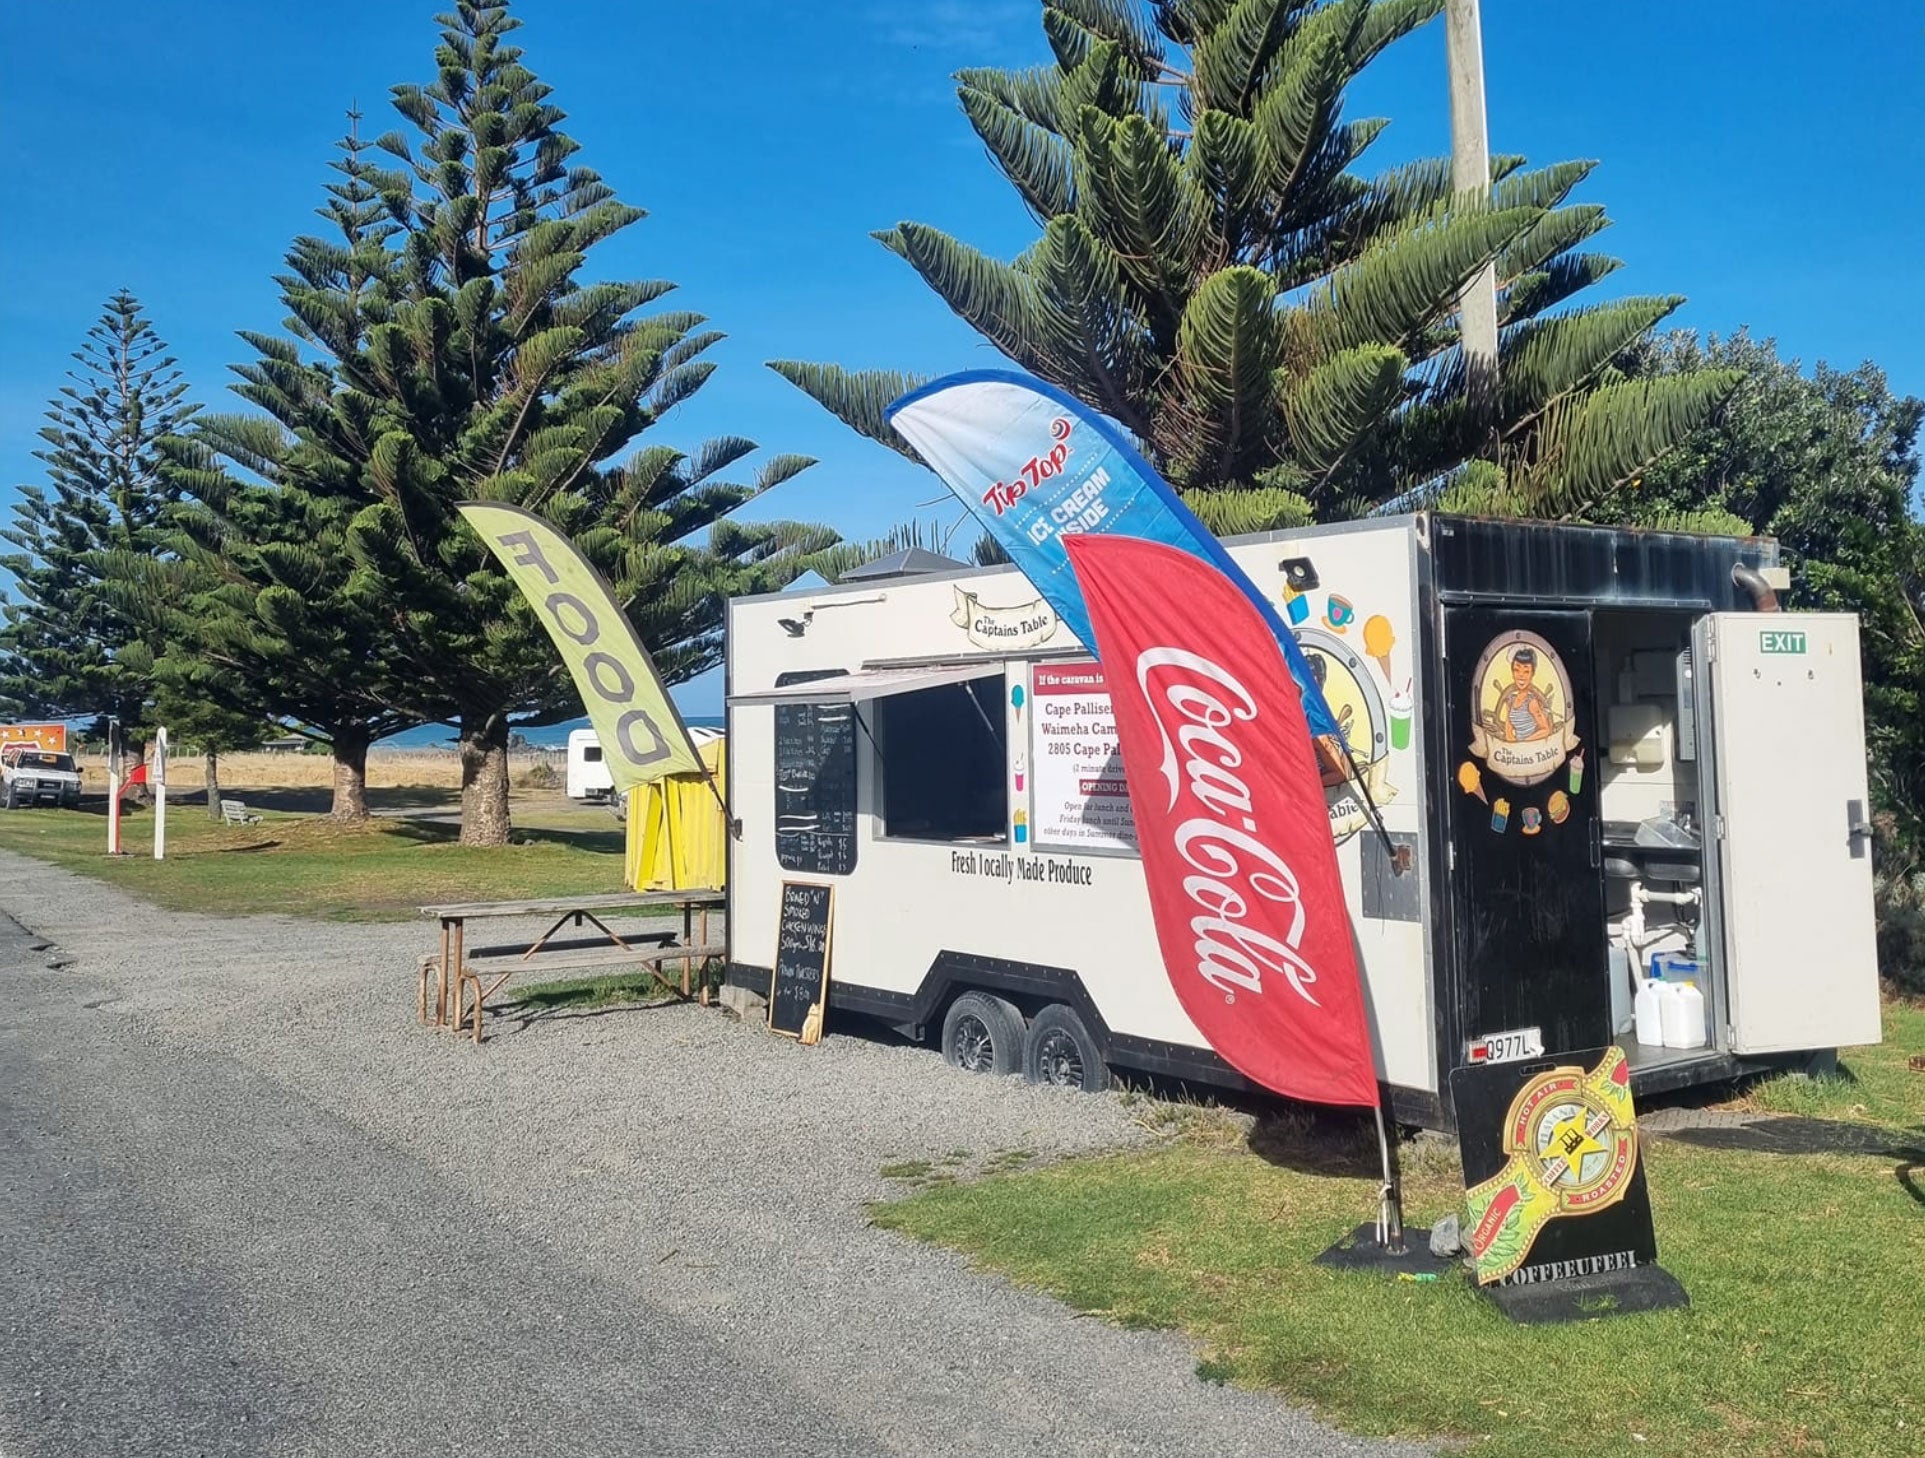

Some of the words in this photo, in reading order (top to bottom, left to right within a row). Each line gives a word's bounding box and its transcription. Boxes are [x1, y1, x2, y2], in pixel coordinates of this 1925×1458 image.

[982, 481, 1027, 516] Tip
[1021, 443, 1068, 487] Top
[1027, 516, 1055, 546] ICE
[1050, 466, 1112, 523] CREAM
[975, 619, 1018, 637] Captains
[1020, 615, 1048, 634] Table
[984, 616, 995, 625] The
[1761, 633, 1804, 652] EXIT
[1039, 674, 1046, 685] If
[1047, 674, 1059, 684] the
[1061, 674, 1094, 684] caravan
[1096, 671, 1104, 683] is
[1045, 702, 1071, 718] Cape
[1041, 722, 1090, 735] Waimeha
[1048, 742, 1071, 755] 2805
[1073, 742, 1101, 759] Cape
[1494, 750, 1534, 766] Captains
[1535, 747, 1559, 763] Table
[1081, 764, 1106, 773] minute
[1082, 782, 1117, 792] OPENING
[1064, 801, 1082, 812] Open
[1095, 802, 1114, 811] lunch
[1116, 803, 1129, 812] and
[1327, 803, 1359, 820] able
[1060, 814, 1081, 825] Friday
[1082, 815, 1101, 824] lunch
[1103, 816, 1119, 825] until
[1136, 646, 1321, 1007] Coca-Cola
[1043, 827, 1060, 835] other
[1062, 828, 1077, 837] days
[1079, 829, 1086, 837] in
[952, 851, 977, 875] Fresh
[1017, 856, 1045, 881] Made
[1047, 858, 1092, 885] Produce
[1486, 1034, 1531, 1060] Q977L
[1519, 1100, 1535, 1126] HOT
[1536, 1082, 1558, 1100] AIR
[1581, 1155, 1627, 1200] ROASTED
[1474, 1207, 1501, 1251] ORGANIC
